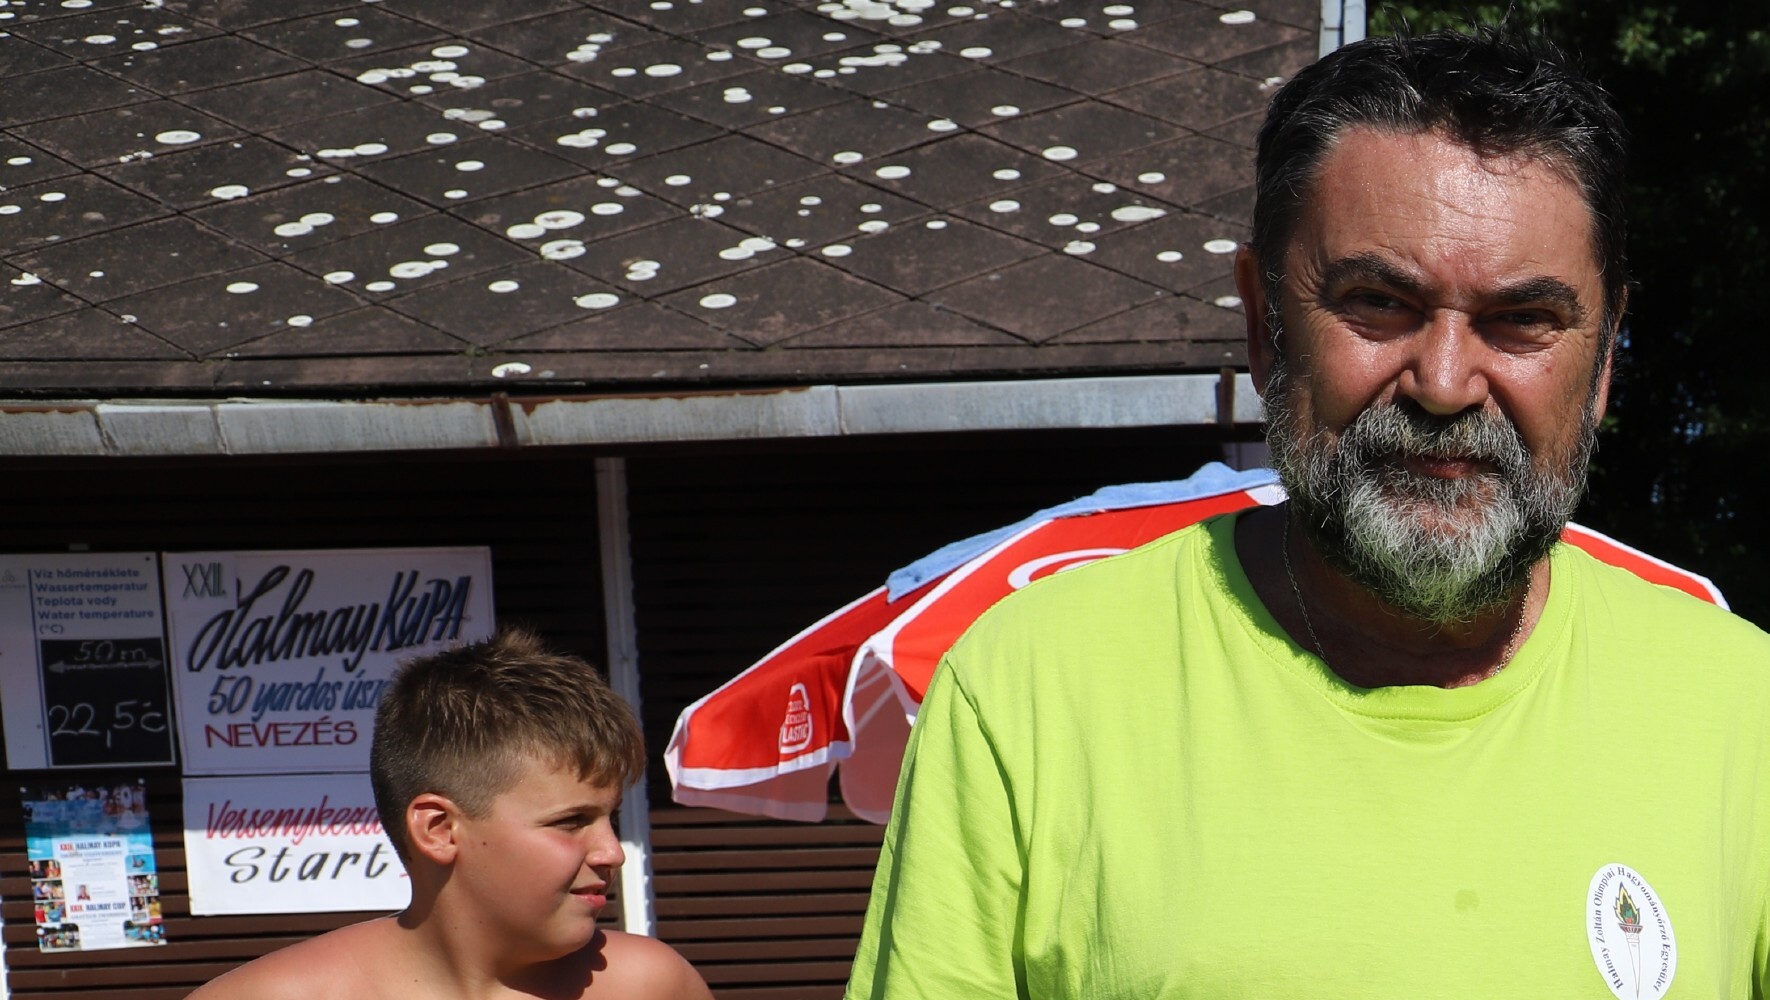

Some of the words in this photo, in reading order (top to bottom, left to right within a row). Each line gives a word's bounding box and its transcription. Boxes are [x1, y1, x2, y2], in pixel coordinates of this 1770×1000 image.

[35, 582, 148, 594] Wassertemperatur
[182, 562, 227, 599] XXII.
[37, 596, 83, 608] Teplota
[87, 596, 117, 608] vody
[38, 610, 75, 621] Water
[79, 609, 155, 622] temperature
[186, 565, 380, 673] Halmay
[73, 640, 114, 662] 50
[208, 674, 252, 715] 50
[252, 667, 342, 723] yardos
[204, 716, 358, 748] NEVEZÉS
[781, 723, 809, 743] LASTIC
[224, 843, 390, 884] Start
[1593, 867, 1616, 906] Olimpiai
[1593, 909, 1606, 943] Zoltán
[1601, 946, 1624, 989] Halmay
[1653, 943, 1671, 992] Egyesület
